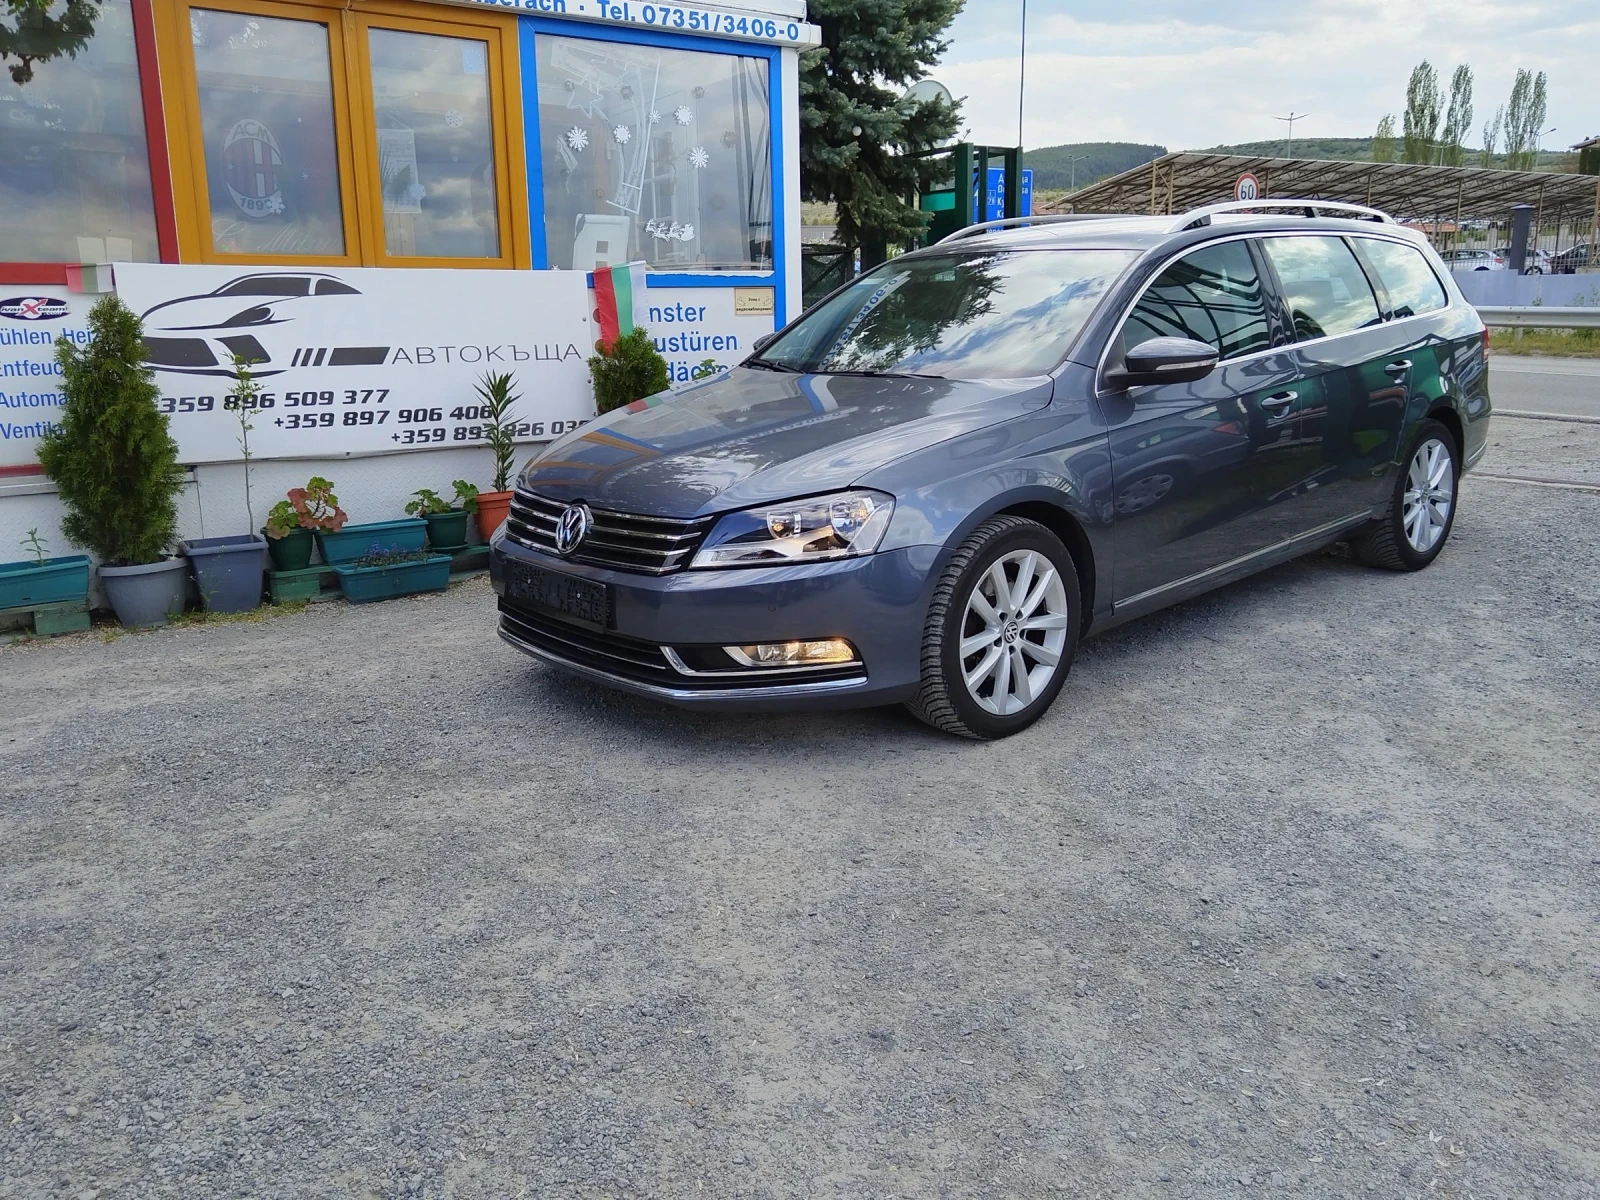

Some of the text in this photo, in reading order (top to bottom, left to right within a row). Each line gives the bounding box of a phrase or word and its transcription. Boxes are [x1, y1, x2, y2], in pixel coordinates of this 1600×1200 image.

[597, 0, 636, 22] Tel.
[642, 5, 799, 41] 07351/3406-0
[1241, 184, 1254, 200] 60
[0, 328, 51, 345] ühlen
[391, 343, 582, 365] АВТОКЪЩА
[223, 393, 276, 410] 896
[284, 391, 334, 407] 509
[342, 389, 390, 404] 377
[274, 406, 493, 429] +359 897 906 406
[391, 428, 446, 444] +359
[453, 426, 492, 441] 89
